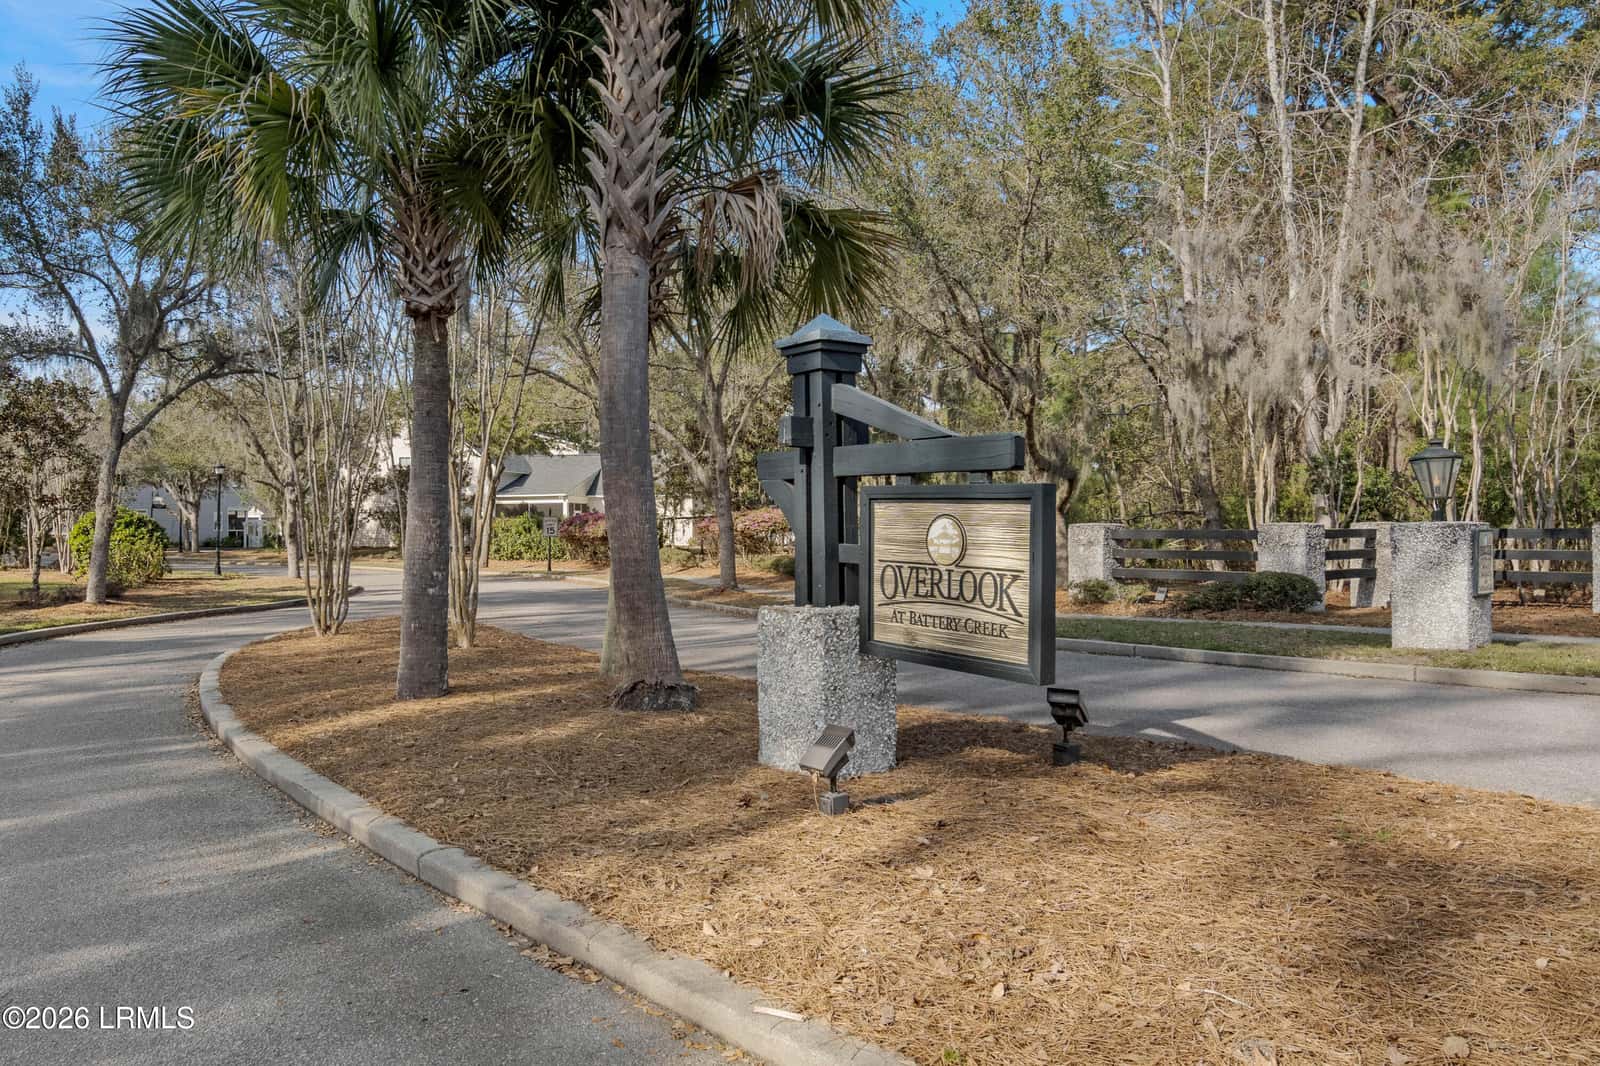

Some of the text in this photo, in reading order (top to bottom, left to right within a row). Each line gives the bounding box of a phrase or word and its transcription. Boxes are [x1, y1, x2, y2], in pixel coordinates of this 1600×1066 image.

[546, 527, 555, 535] 15
[880, 564, 1023, 617] OVERLOOK
[890, 608, 1010, 639] AT BATTERY CREEK
